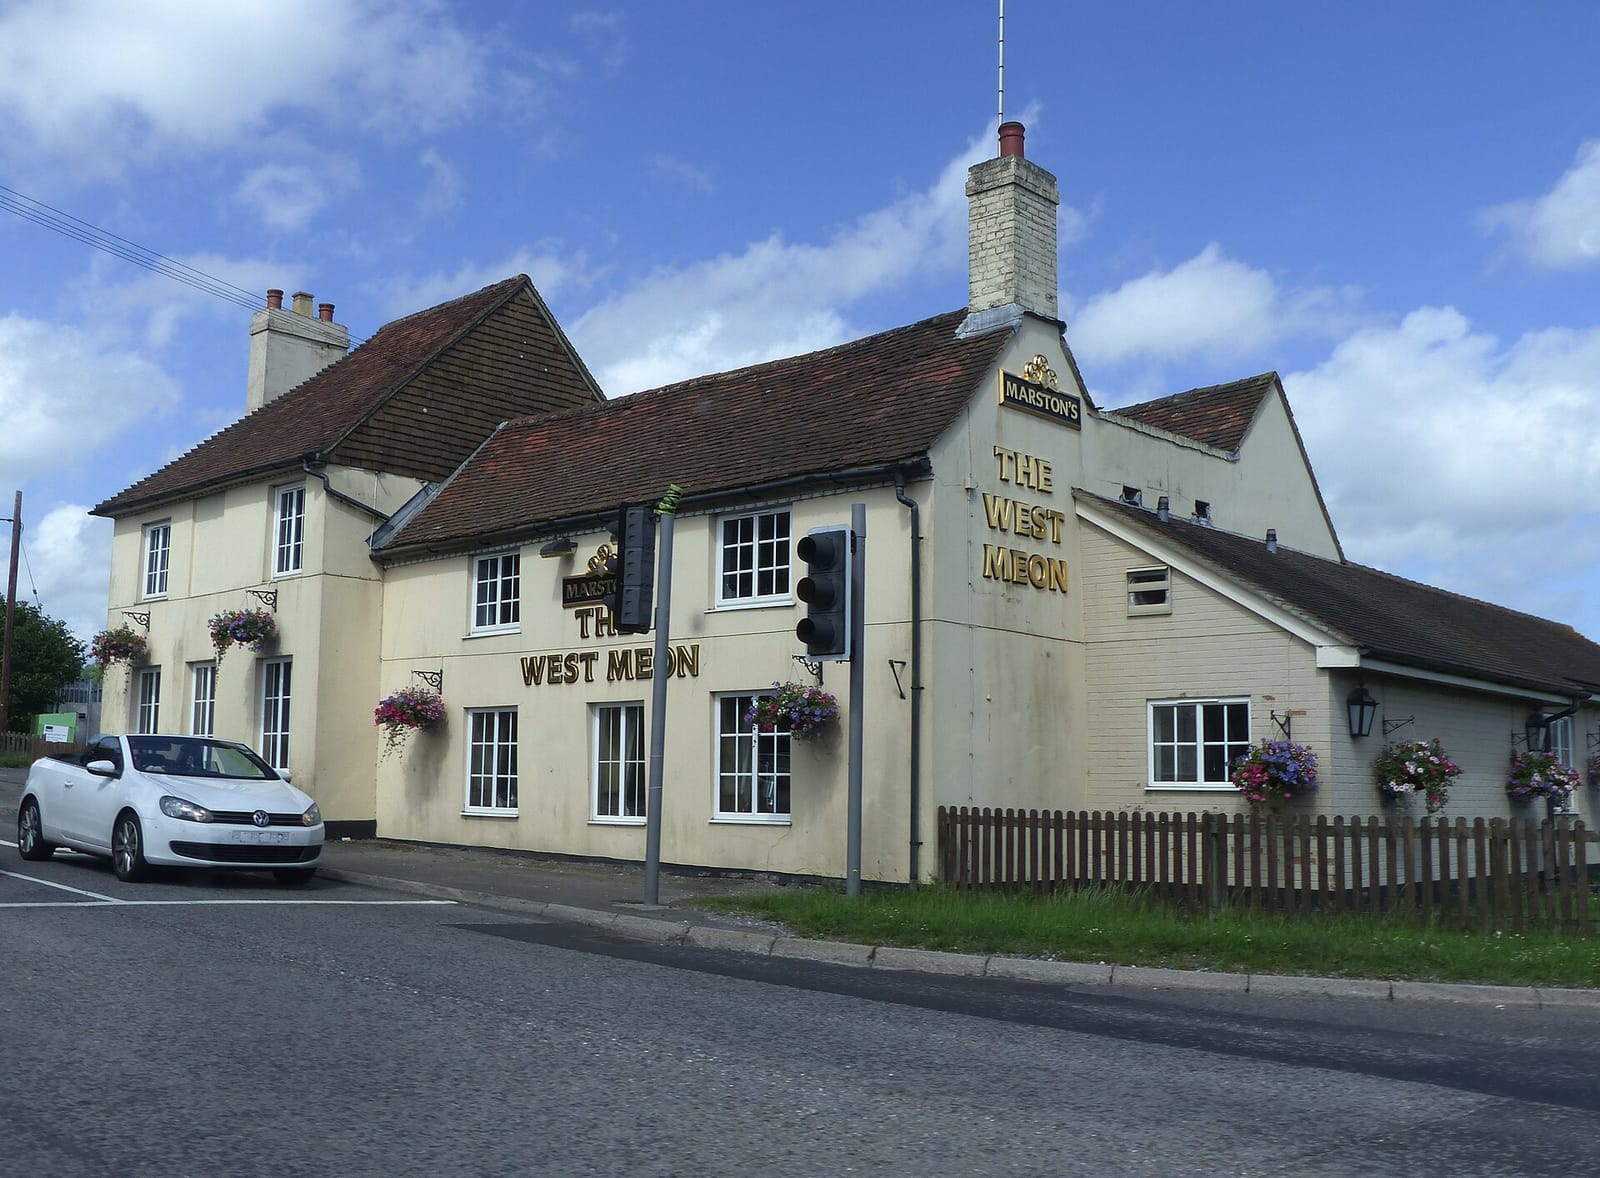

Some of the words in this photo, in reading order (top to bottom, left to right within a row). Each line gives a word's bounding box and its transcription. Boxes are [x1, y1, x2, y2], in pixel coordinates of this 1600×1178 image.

[1006, 380, 1078, 420] MARSTON'S
[994, 446, 1053, 494] THE
[983, 493, 1065, 544] WEST
[983, 544, 1068, 593] MEON
[566, 581, 617, 599] MARST
[575, 606, 634, 638] TH
[520, 652, 599, 686] WEST
